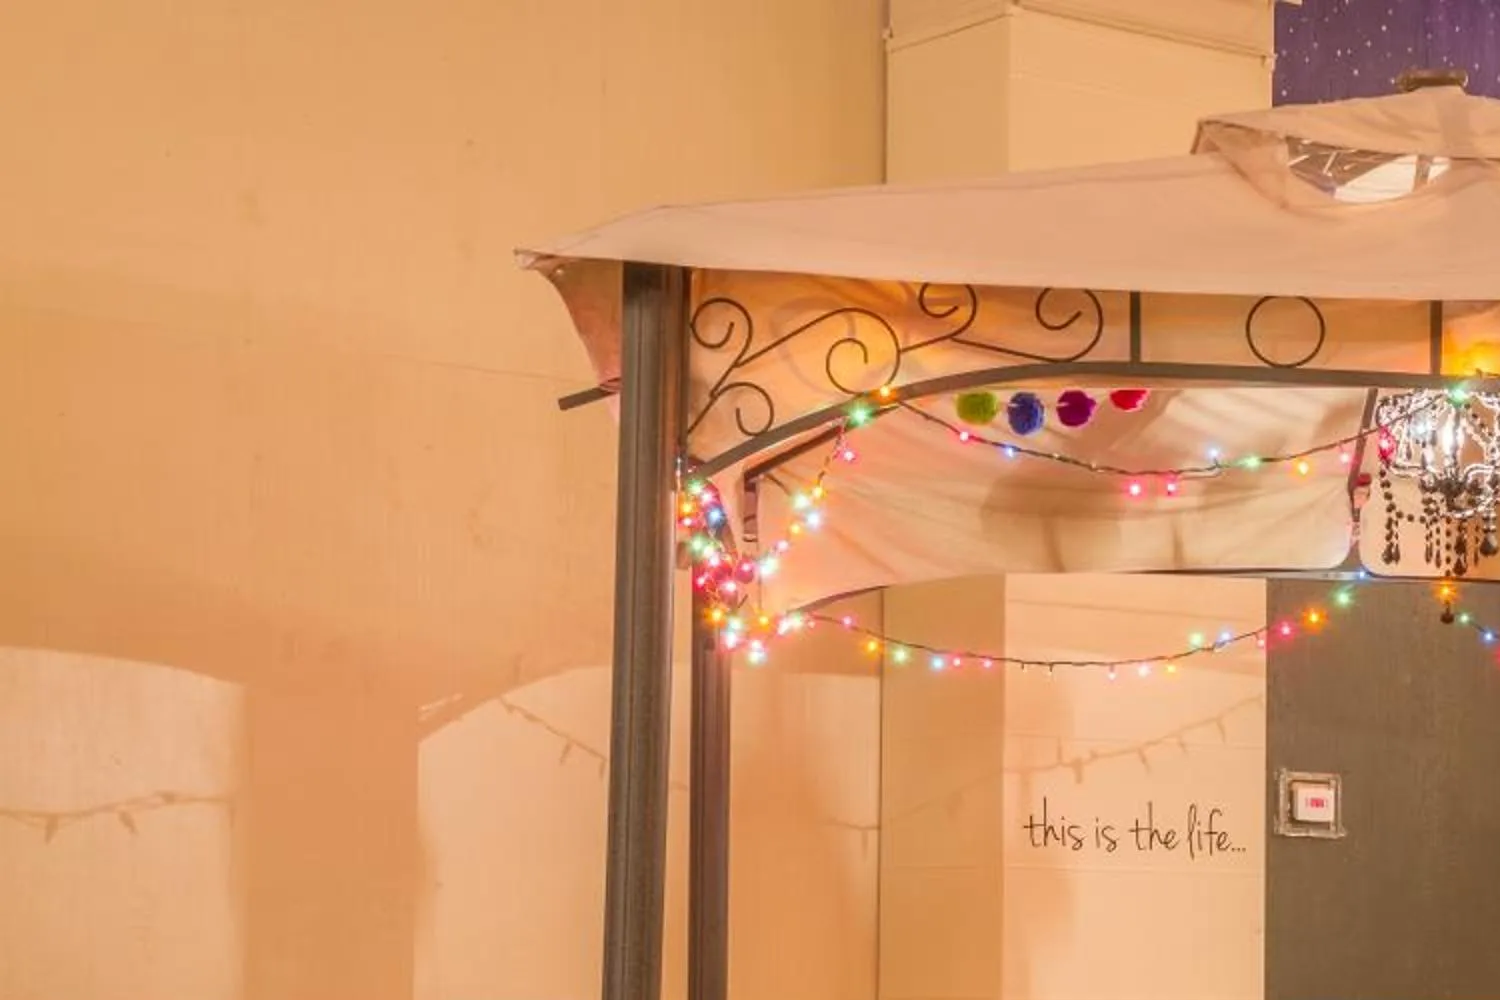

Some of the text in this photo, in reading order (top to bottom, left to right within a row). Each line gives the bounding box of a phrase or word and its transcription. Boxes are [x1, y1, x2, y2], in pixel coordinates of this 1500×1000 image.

[1023, 796, 1085, 851] this
[1095, 817, 1120, 852] is
[1129, 801, 1180, 851] the
